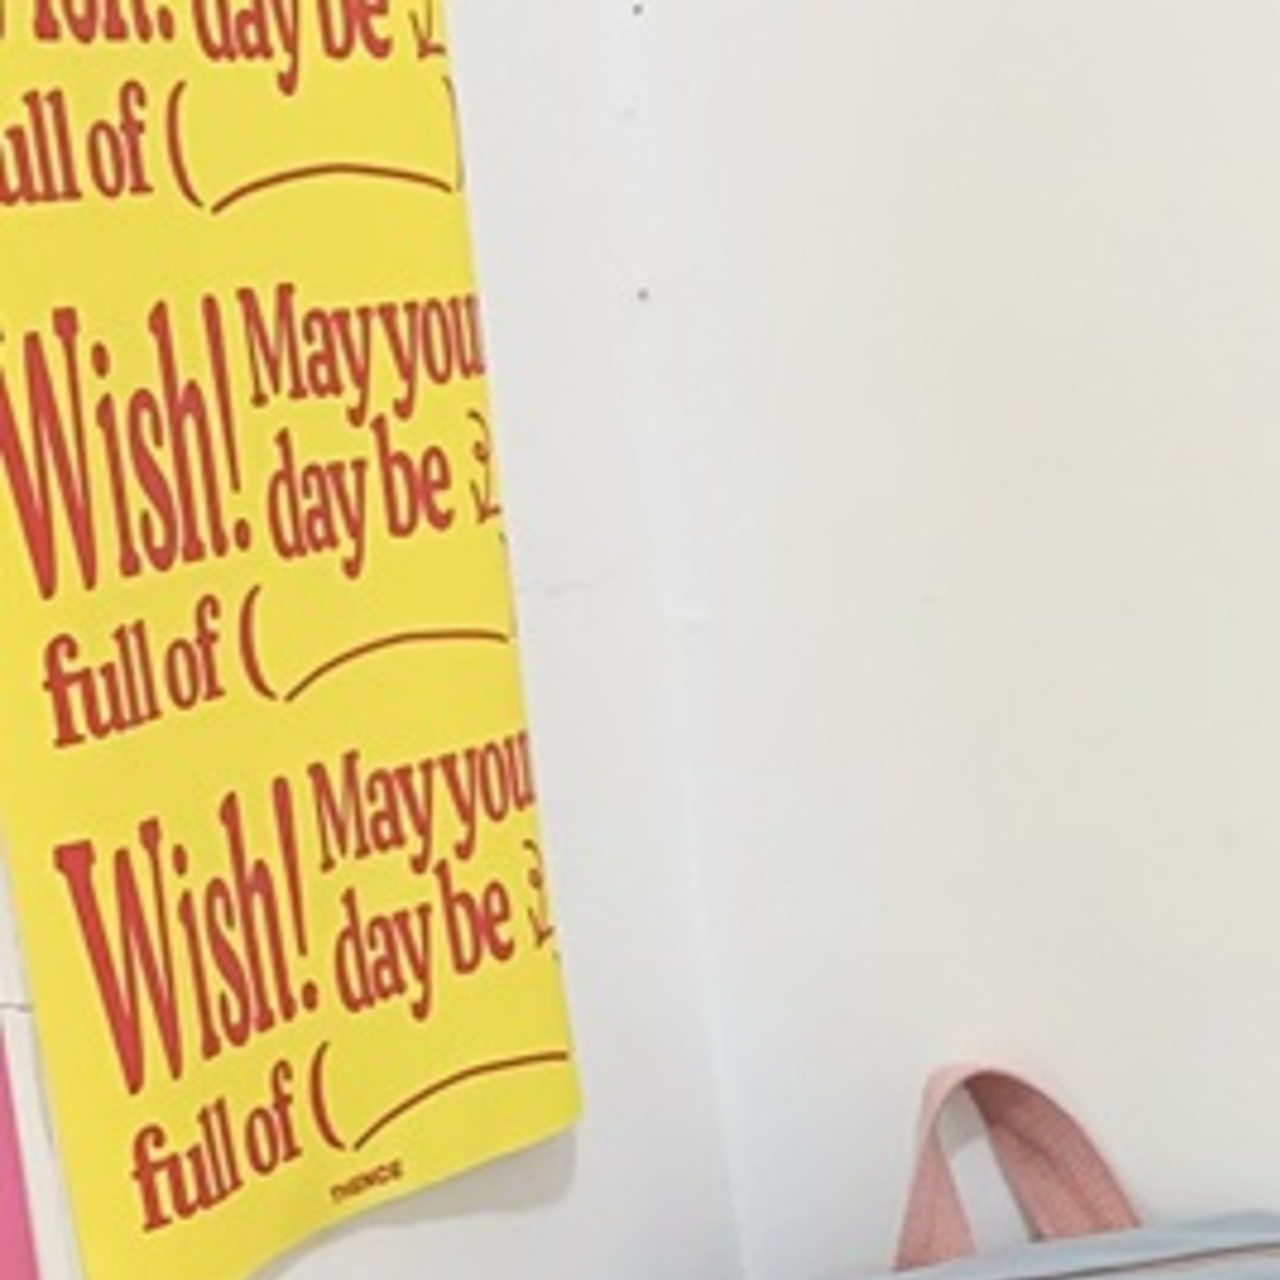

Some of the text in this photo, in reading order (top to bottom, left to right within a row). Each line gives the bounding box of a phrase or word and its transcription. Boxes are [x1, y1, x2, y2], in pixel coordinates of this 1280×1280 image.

[0, 80, 153, 206] ull of
[236, 282, 372, 428] May
[0, 294, 251, 599] Wish!
[267, 415, 455, 580] day be
[42, 594, 226, 749] full of
[307, 748, 434, 875] May
[53, 775, 320, 1095] Wish!
[334, 859, 514, 1022] day be
[131, 1059, 303, 1232] full of
